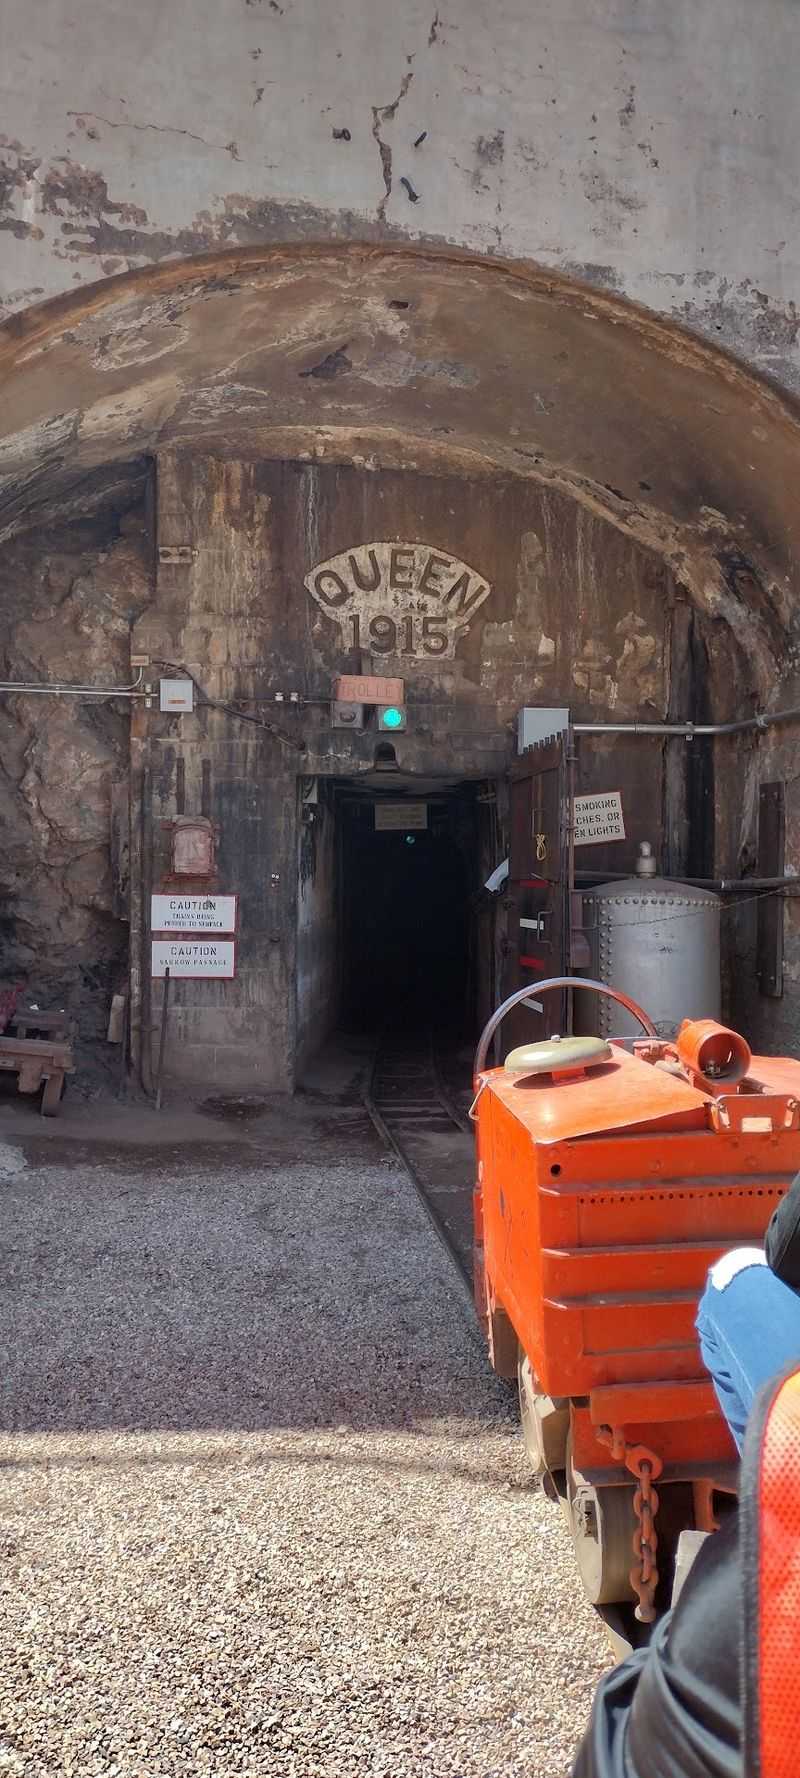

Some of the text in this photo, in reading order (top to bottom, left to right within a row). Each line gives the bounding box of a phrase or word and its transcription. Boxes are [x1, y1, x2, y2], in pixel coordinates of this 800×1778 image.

[314, 549, 486, 616] QUEEN
[350, 614, 449, 654] 1915
[340, 682, 402, 698] TROLLE
[575, 800, 616, 812] SMOKING
[607, 812, 619, 821] OR
[588, 825, 620, 836] LIGHTS
[169, 901, 216, 911] CAUTION
[170, 946, 217, 956] CAUTION
